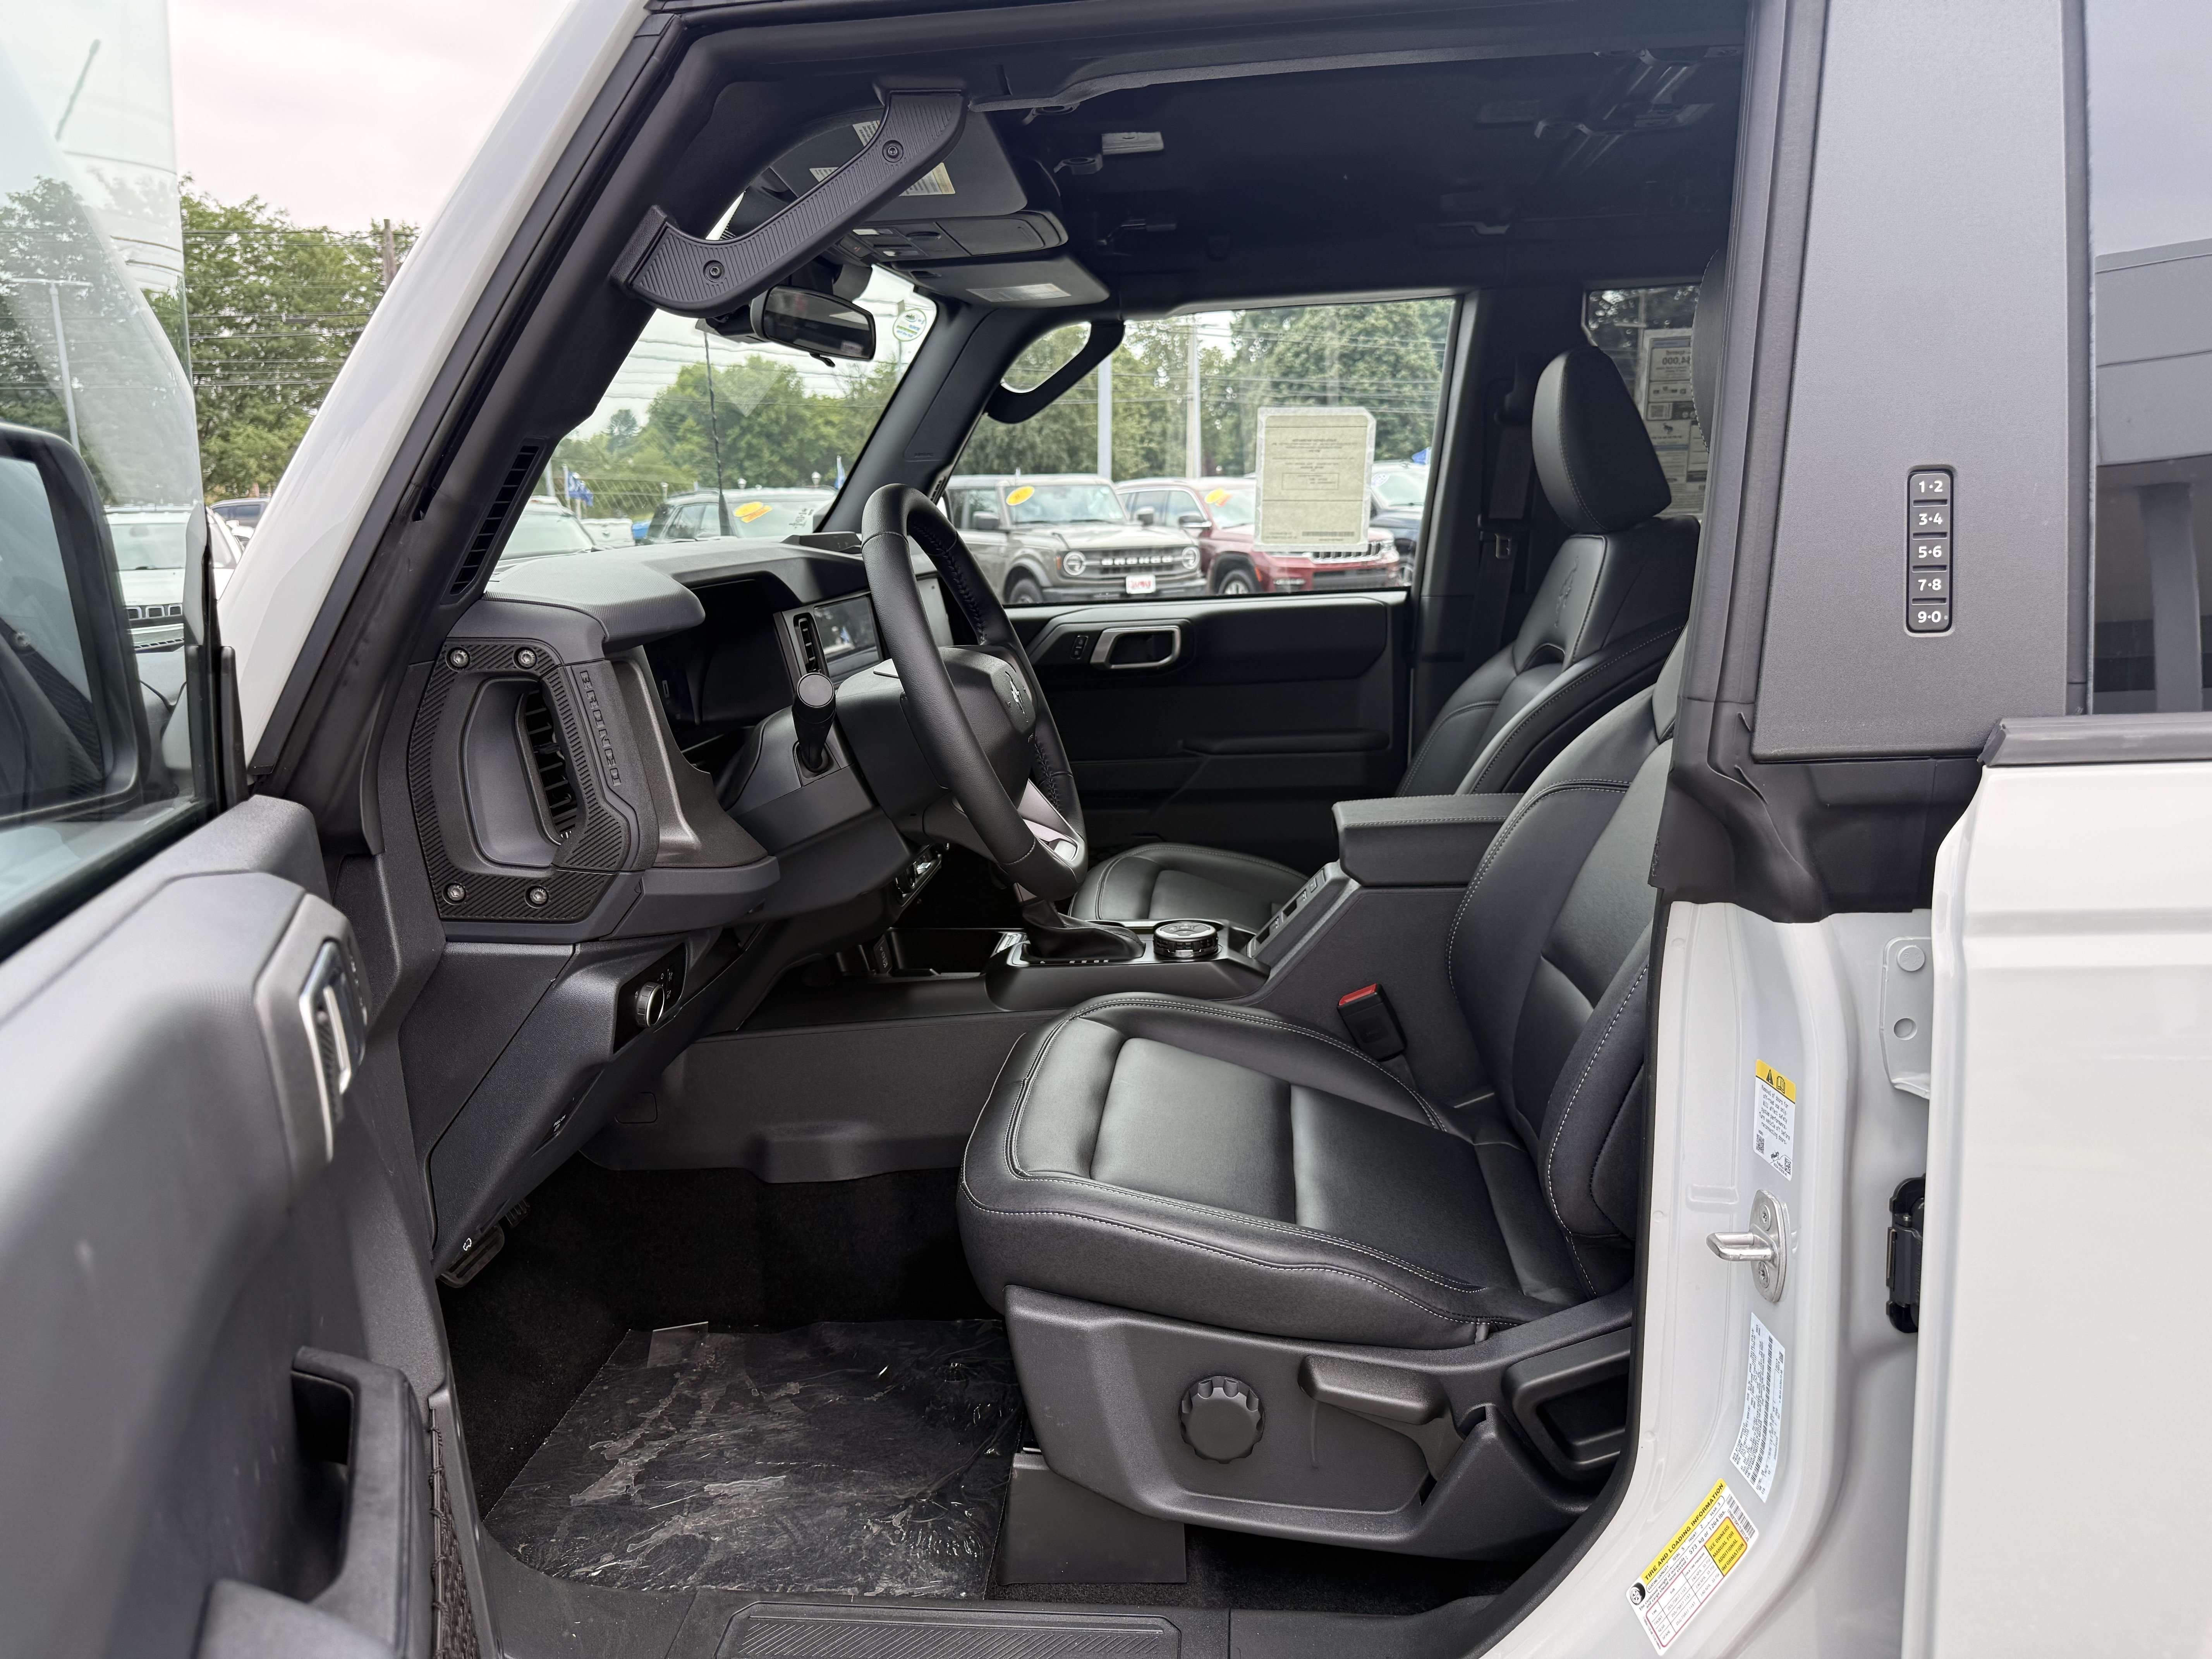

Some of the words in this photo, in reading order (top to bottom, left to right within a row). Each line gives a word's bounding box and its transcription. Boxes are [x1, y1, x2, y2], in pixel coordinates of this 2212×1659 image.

[579, 670, 622, 786] BRONCO
[1644, 1565, 1657, 1582] TIRE
[1657, 1551, 1669, 1567] AND
[1668, 1524, 1691, 1554] LOADING
[1690, 1482, 1724, 1527] INFORMATION
[1689, 1543, 1697, 1555] 573
[1698, 1536, 1704, 1545] kg
[1709, 1517, 1719, 1531] 1264
[1712, 1539, 1727, 1558] MANUAL
[1726, 1530, 1734, 1541] FOR
[1715, 1524, 1730, 1544] OWNERS
[1717, 1538, 1738, 1564] ADDITIONAL
[1721, 1542, 1744, 1572] INFORMATION
